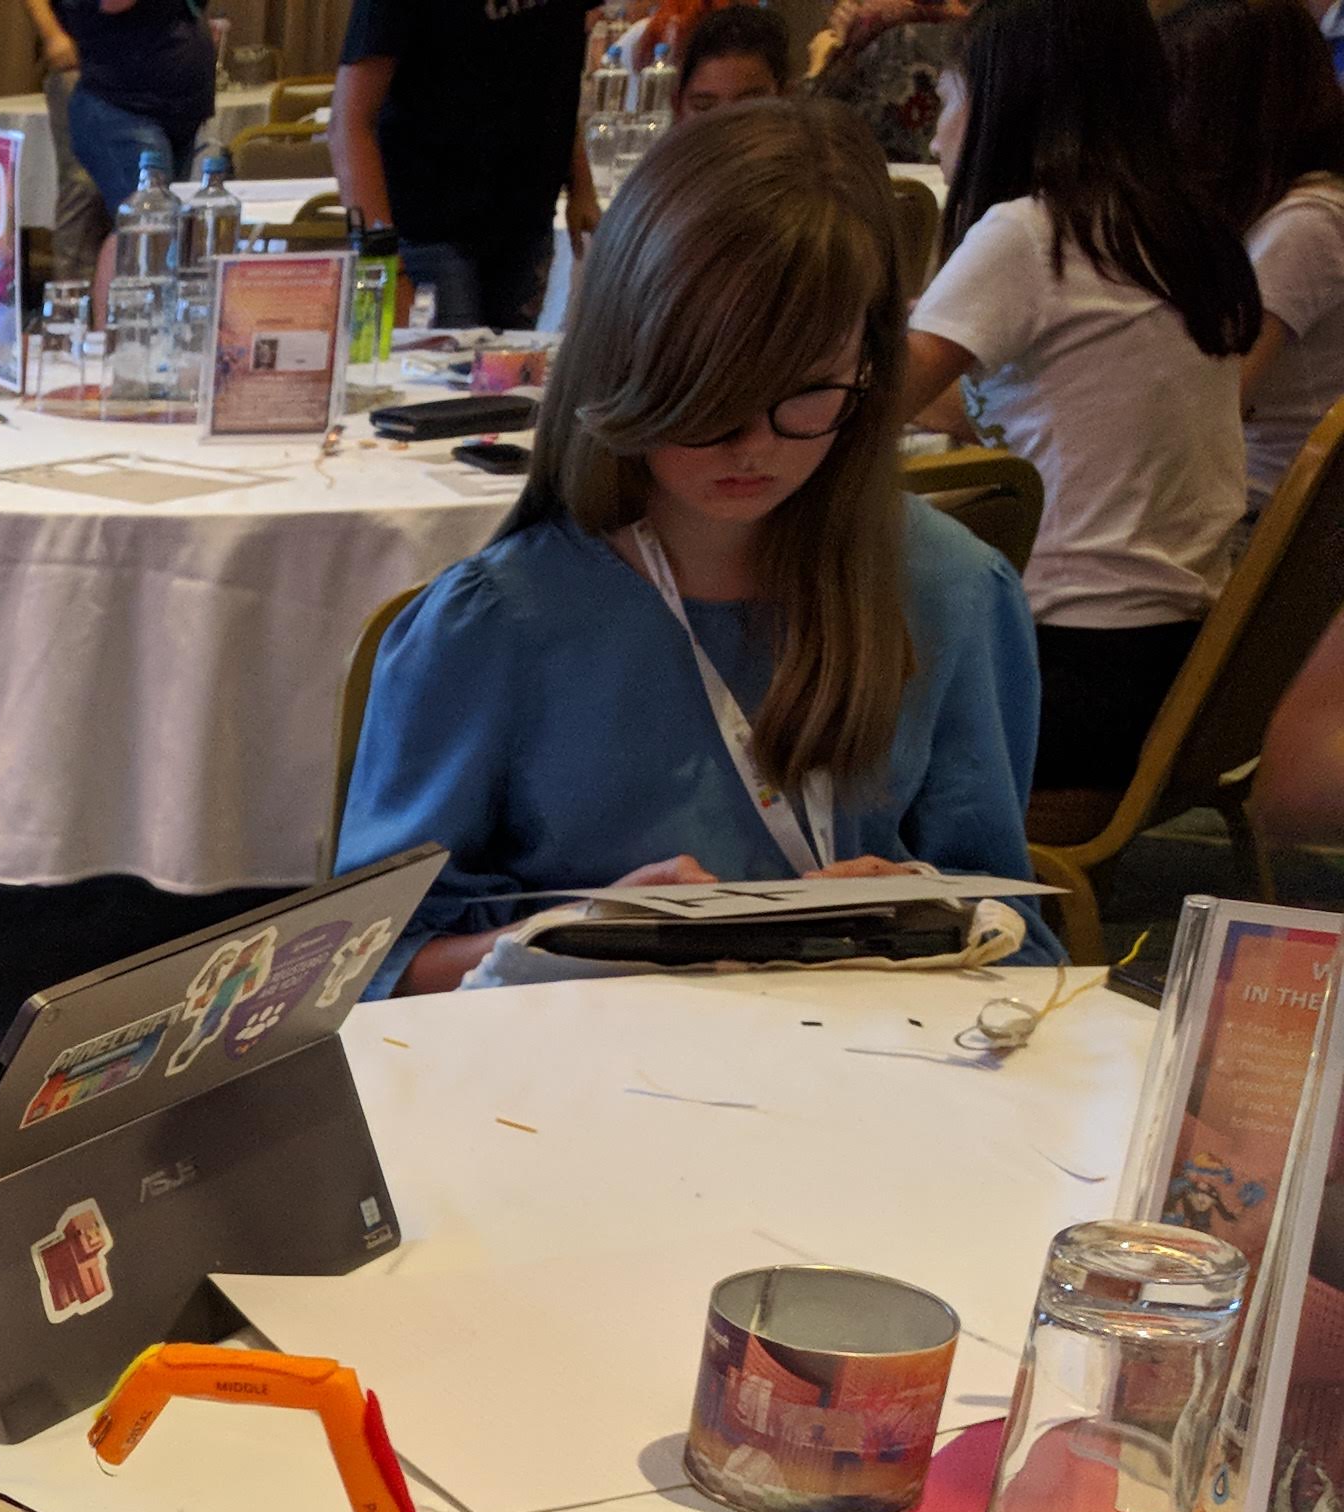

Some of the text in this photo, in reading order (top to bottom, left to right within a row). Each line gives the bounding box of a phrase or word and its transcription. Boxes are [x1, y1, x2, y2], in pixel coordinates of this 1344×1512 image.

[1242, 984, 1322, 1012] IN THE
[53, 1005, 186, 1076] MINECRAFT
[139, 1157, 199, 1204] ASUS
[215, 1380, 270, 1396] MIDDLE
